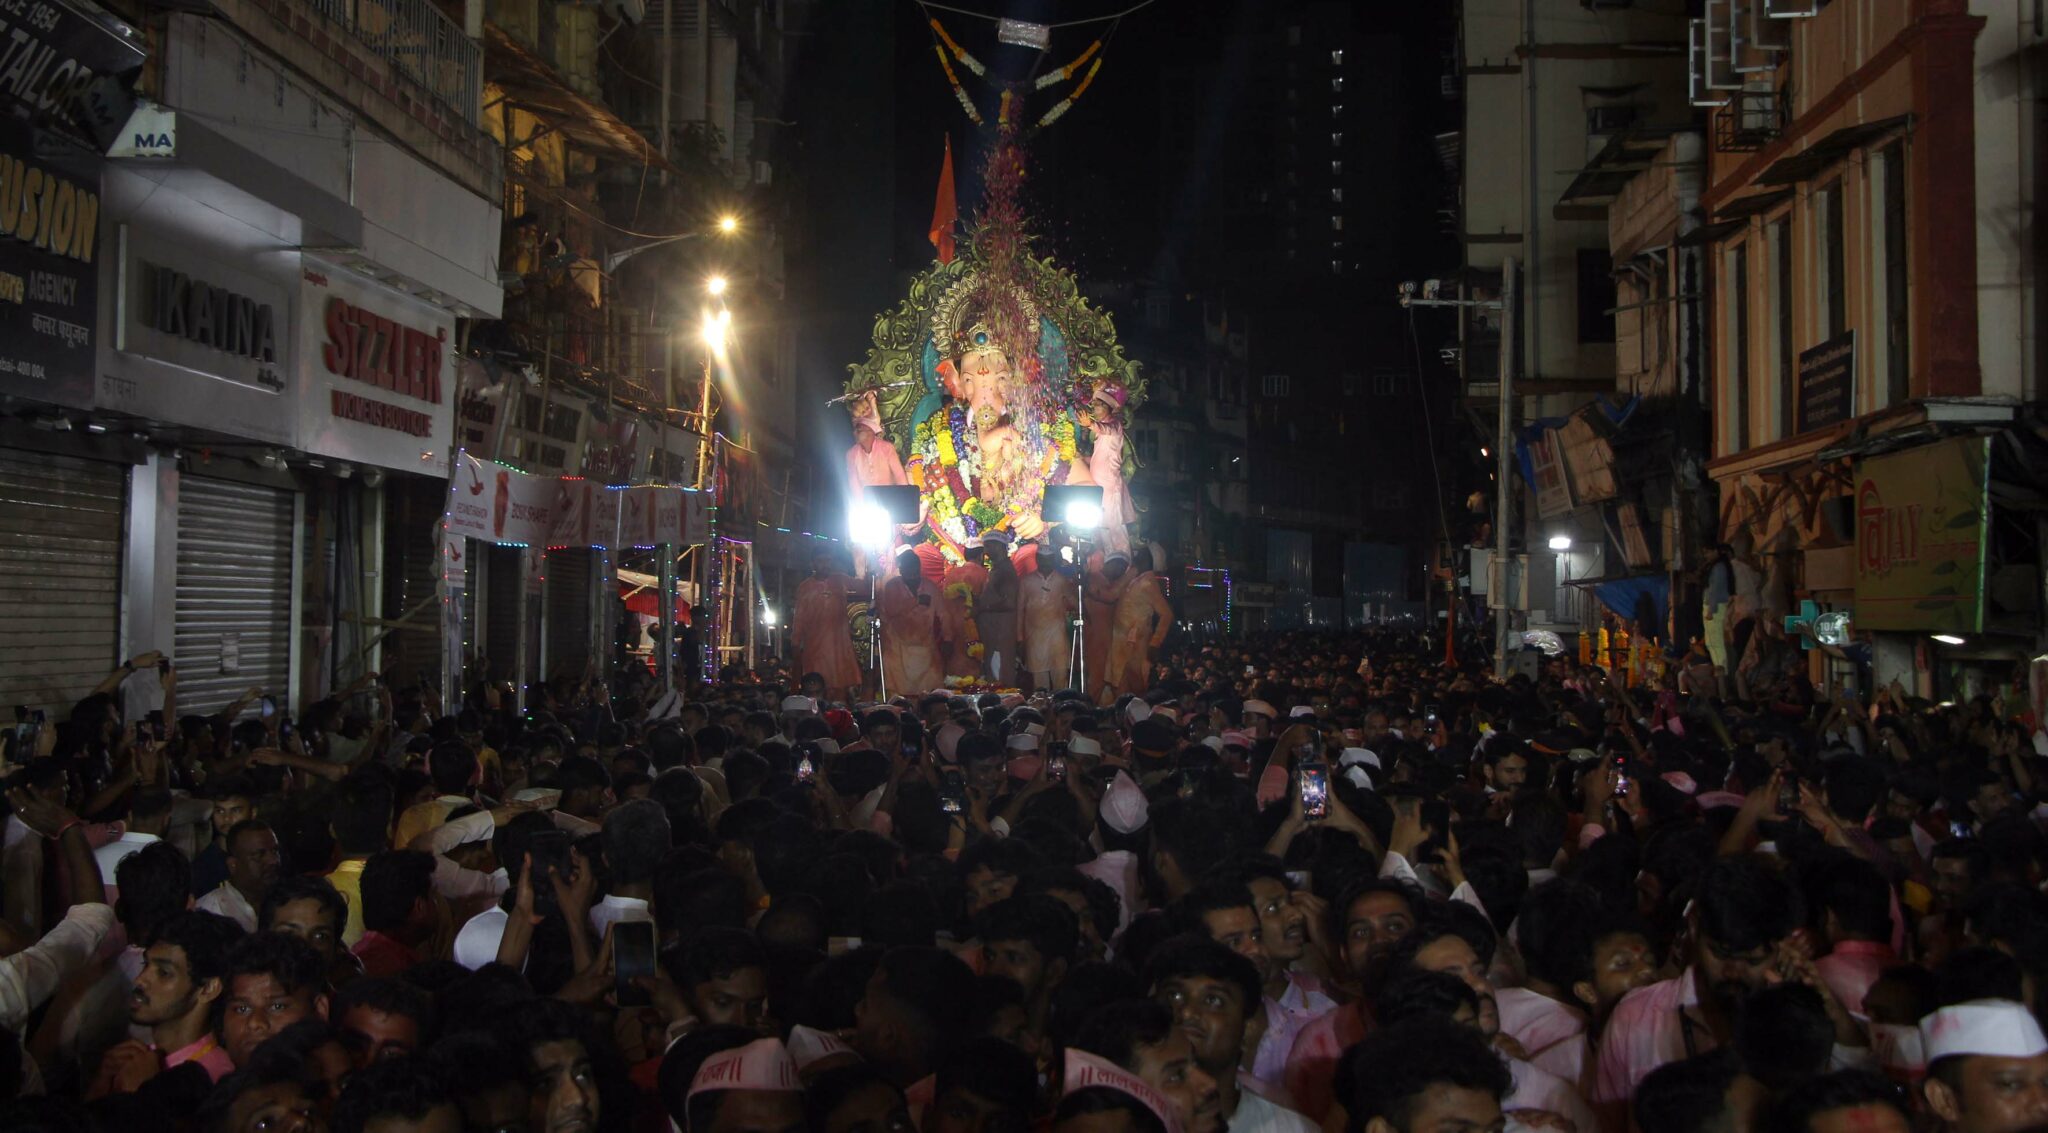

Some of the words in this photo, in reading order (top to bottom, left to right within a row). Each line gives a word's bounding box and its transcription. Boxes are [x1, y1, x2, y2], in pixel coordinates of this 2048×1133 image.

[27, 2, 61, 32] 1954
[0, 153, 98, 263] USION
[28, 270, 78, 306] AGENCY
